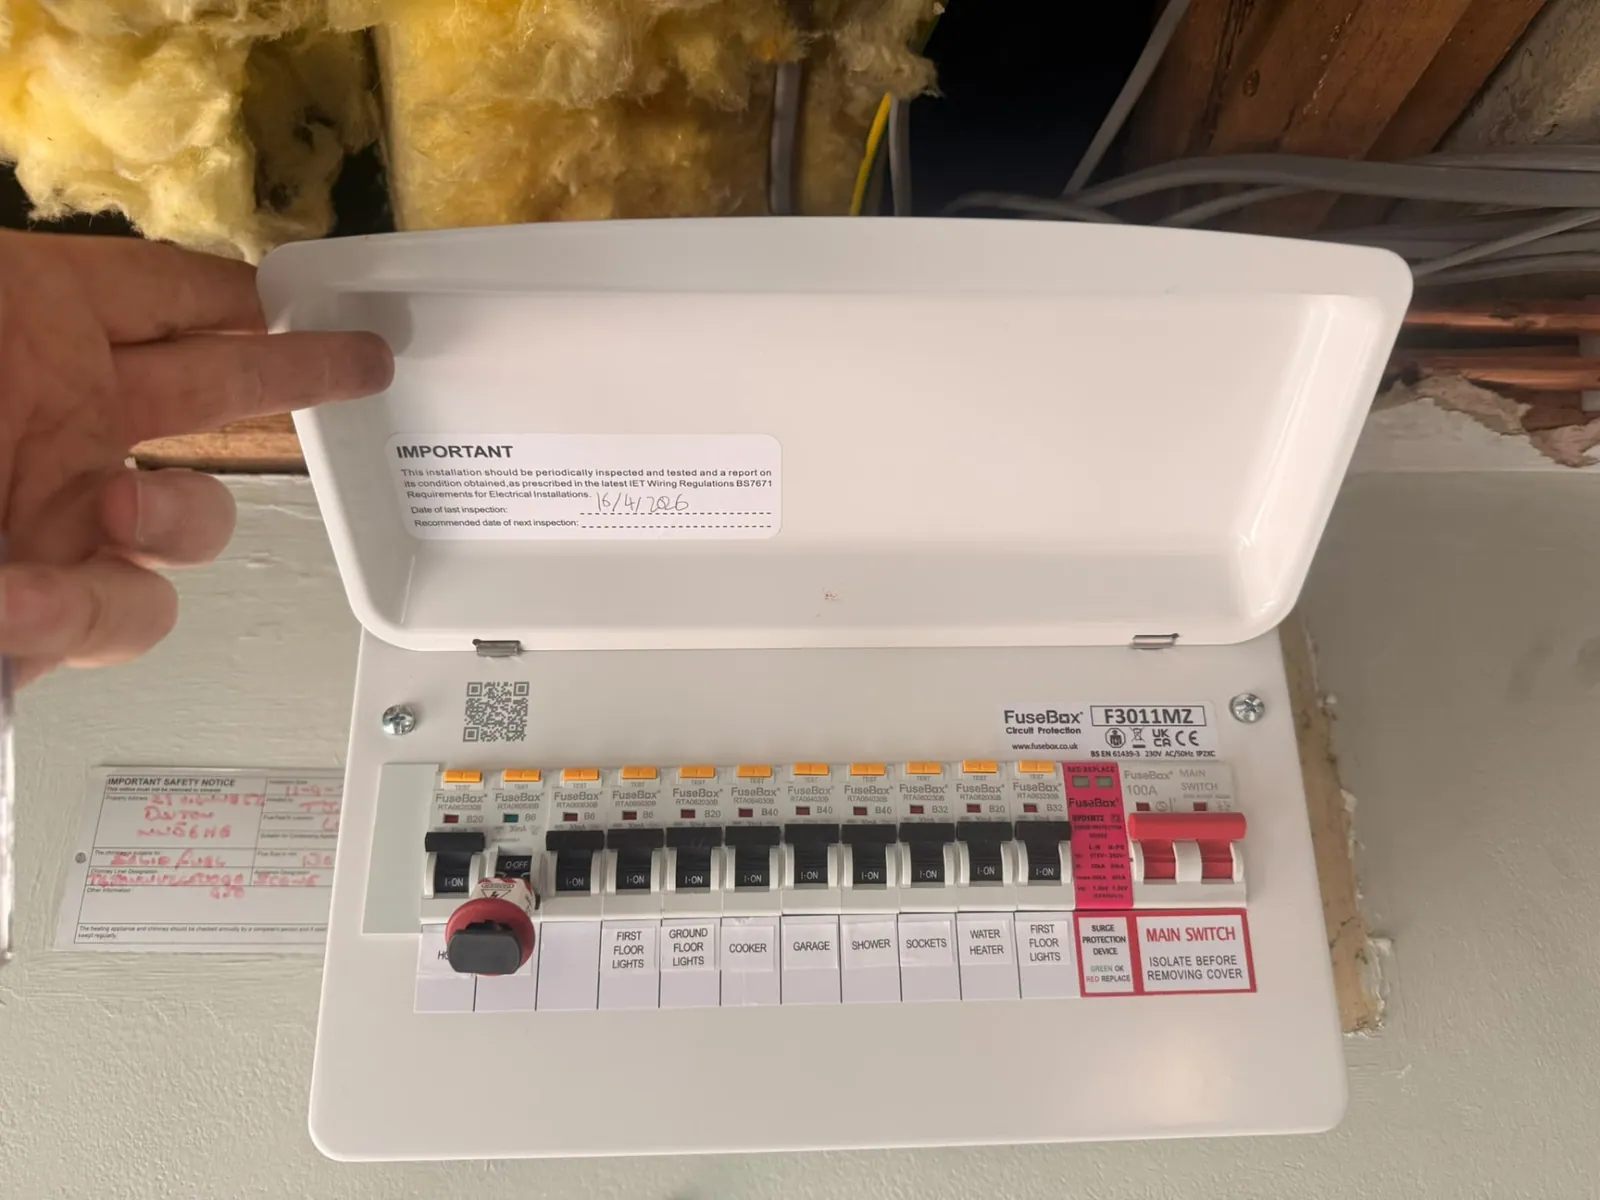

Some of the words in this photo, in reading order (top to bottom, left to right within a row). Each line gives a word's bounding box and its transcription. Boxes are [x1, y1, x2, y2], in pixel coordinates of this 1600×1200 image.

[396, 445, 514, 458] IMPORTANT
[401, 468, 424, 478] This
[426, 468, 482, 478] installation
[484, 468, 518, 478] should
[520, 468, 532, 478] be
[536, 468, 593, 478] periodically
[596, 468, 644, 478] inspected
[646, 468, 664, 478] and
[666, 468, 697, 478] tested
[700, 468, 718, 478] and
[728, 468, 758, 478] report
[404, 480, 416, 488] its
[418, 480, 462, 488] condition
[522, 480, 573, 488] prescribed
[574, 480, 582, 488] in
[584, 480, 600, 488] the
[602, 480, 628, 488] latest
[629, 480, 644, 488] IET
[648, 480, 677, 488] Wiring
[680, 480, 734, 488] Regulations
[736, 480, 772, 488] BS7671
[407, 490, 474, 498] Requirements
[474, 490, 488, 498] for
[490, 490, 532, 498] Electrical
[534, 490, 592, 498] Installations.
[411, 506, 432, 514] Date
[434, 506, 444, 514] of
[444, 506, 460, 514] last
[462, 506, 508, 514] inspection:
[414, 520, 480, 528] Recommended
[482, 520, 500, 528] date
[502, 520, 512, 528] of
[514, 520, 532, 528] next
[534, 520, 579, 528] inspection:
[1004, 710, 1083, 724] FuseBox
[1104, 708, 1194, 724] F3011MZ
[1006, 726, 1034, 735] Circuit
[1038, 726, 1082, 735] Protection
[1090, 750, 1100, 758] BS
[1100, 750, 1112, 758] EN
[1113, 750, 1140, 758] 61439-3
[1144, 750, 1162, 758] 230V
[1124, 770, 1173, 780] FuseBox
[1179, 770, 1206, 778] MAIN
[164, 778, 198, 786] SAFETY
[1013, 782, 1062, 792] FuseBox
[1180, 782, 1218, 791] SWITCH
[672, 788, 722, 798] FuseBox
[731, 787, 780, 796] FuseBox
[788, 786, 834, 794] FuseBox
[844, 785, 893, 794] FuseBox
[900, 784, 948, 793] FuseBox
[956, 784, 1004, 793] FuseBox
[1126, 784, 1158, 796] 100A
[436, 793, 487, 803] FuseBox
[495, 792, 543, 802] FuseBox
[554, 792, 602, 800] FuseBox
[612, 790, 660, 799] FuseBox
[762, 808, 778, 816] B40
[817, 806, 832, 814] B40
[875, 806, 892, 814] B40
[932, 806, 948, 814] B32
[989, 805, 1005, 813] B20
[1047, 804, 1062, 812] B32
[704, 810, 721, 818] B20
[1030, 924, 1054, 934] FIRST
[1092, 924, 1114, 932] SURGE
[617, 931, 642, 941] FIRST
[669, 928, 708, 939] GROUND
[970, 929, 1000, 939] WATER
[1146, 928, 1180, 942] MAIN
[1185, 926, 1235, 941] SWITCH
[852, 939, 891, 950] SHOWER
[906, 938, 947, 949] SOCKETS
[1029, 937, 1059, 948] FLOOR
[1082, 936, 1126, 944] PROTECTION
[614, 945, 644, 955] FLOOR
[673, 942, 704, 953] FLOOR
[729, 943, 767, 953] COOKER
[793, 941, 830, 951] GARAGE
[969, 945, 1004, 956] HEATER
[672, 956, 704, 966] LIGHTS
[1029, 952, 1060, 962] LIGHTS
[1150, 956, 1192, 967] ISOLATE
[1196, 955, 1237, 965] BEFORE
[612, 959, 644, 969] LIGHTS
[1090, 964, 1112, 972] GREEN
[1114, 964, 1124, 972] OK
[1147, 970, 1203, 981] REMOVING
[1208, 968, 1243, 979] COVER
